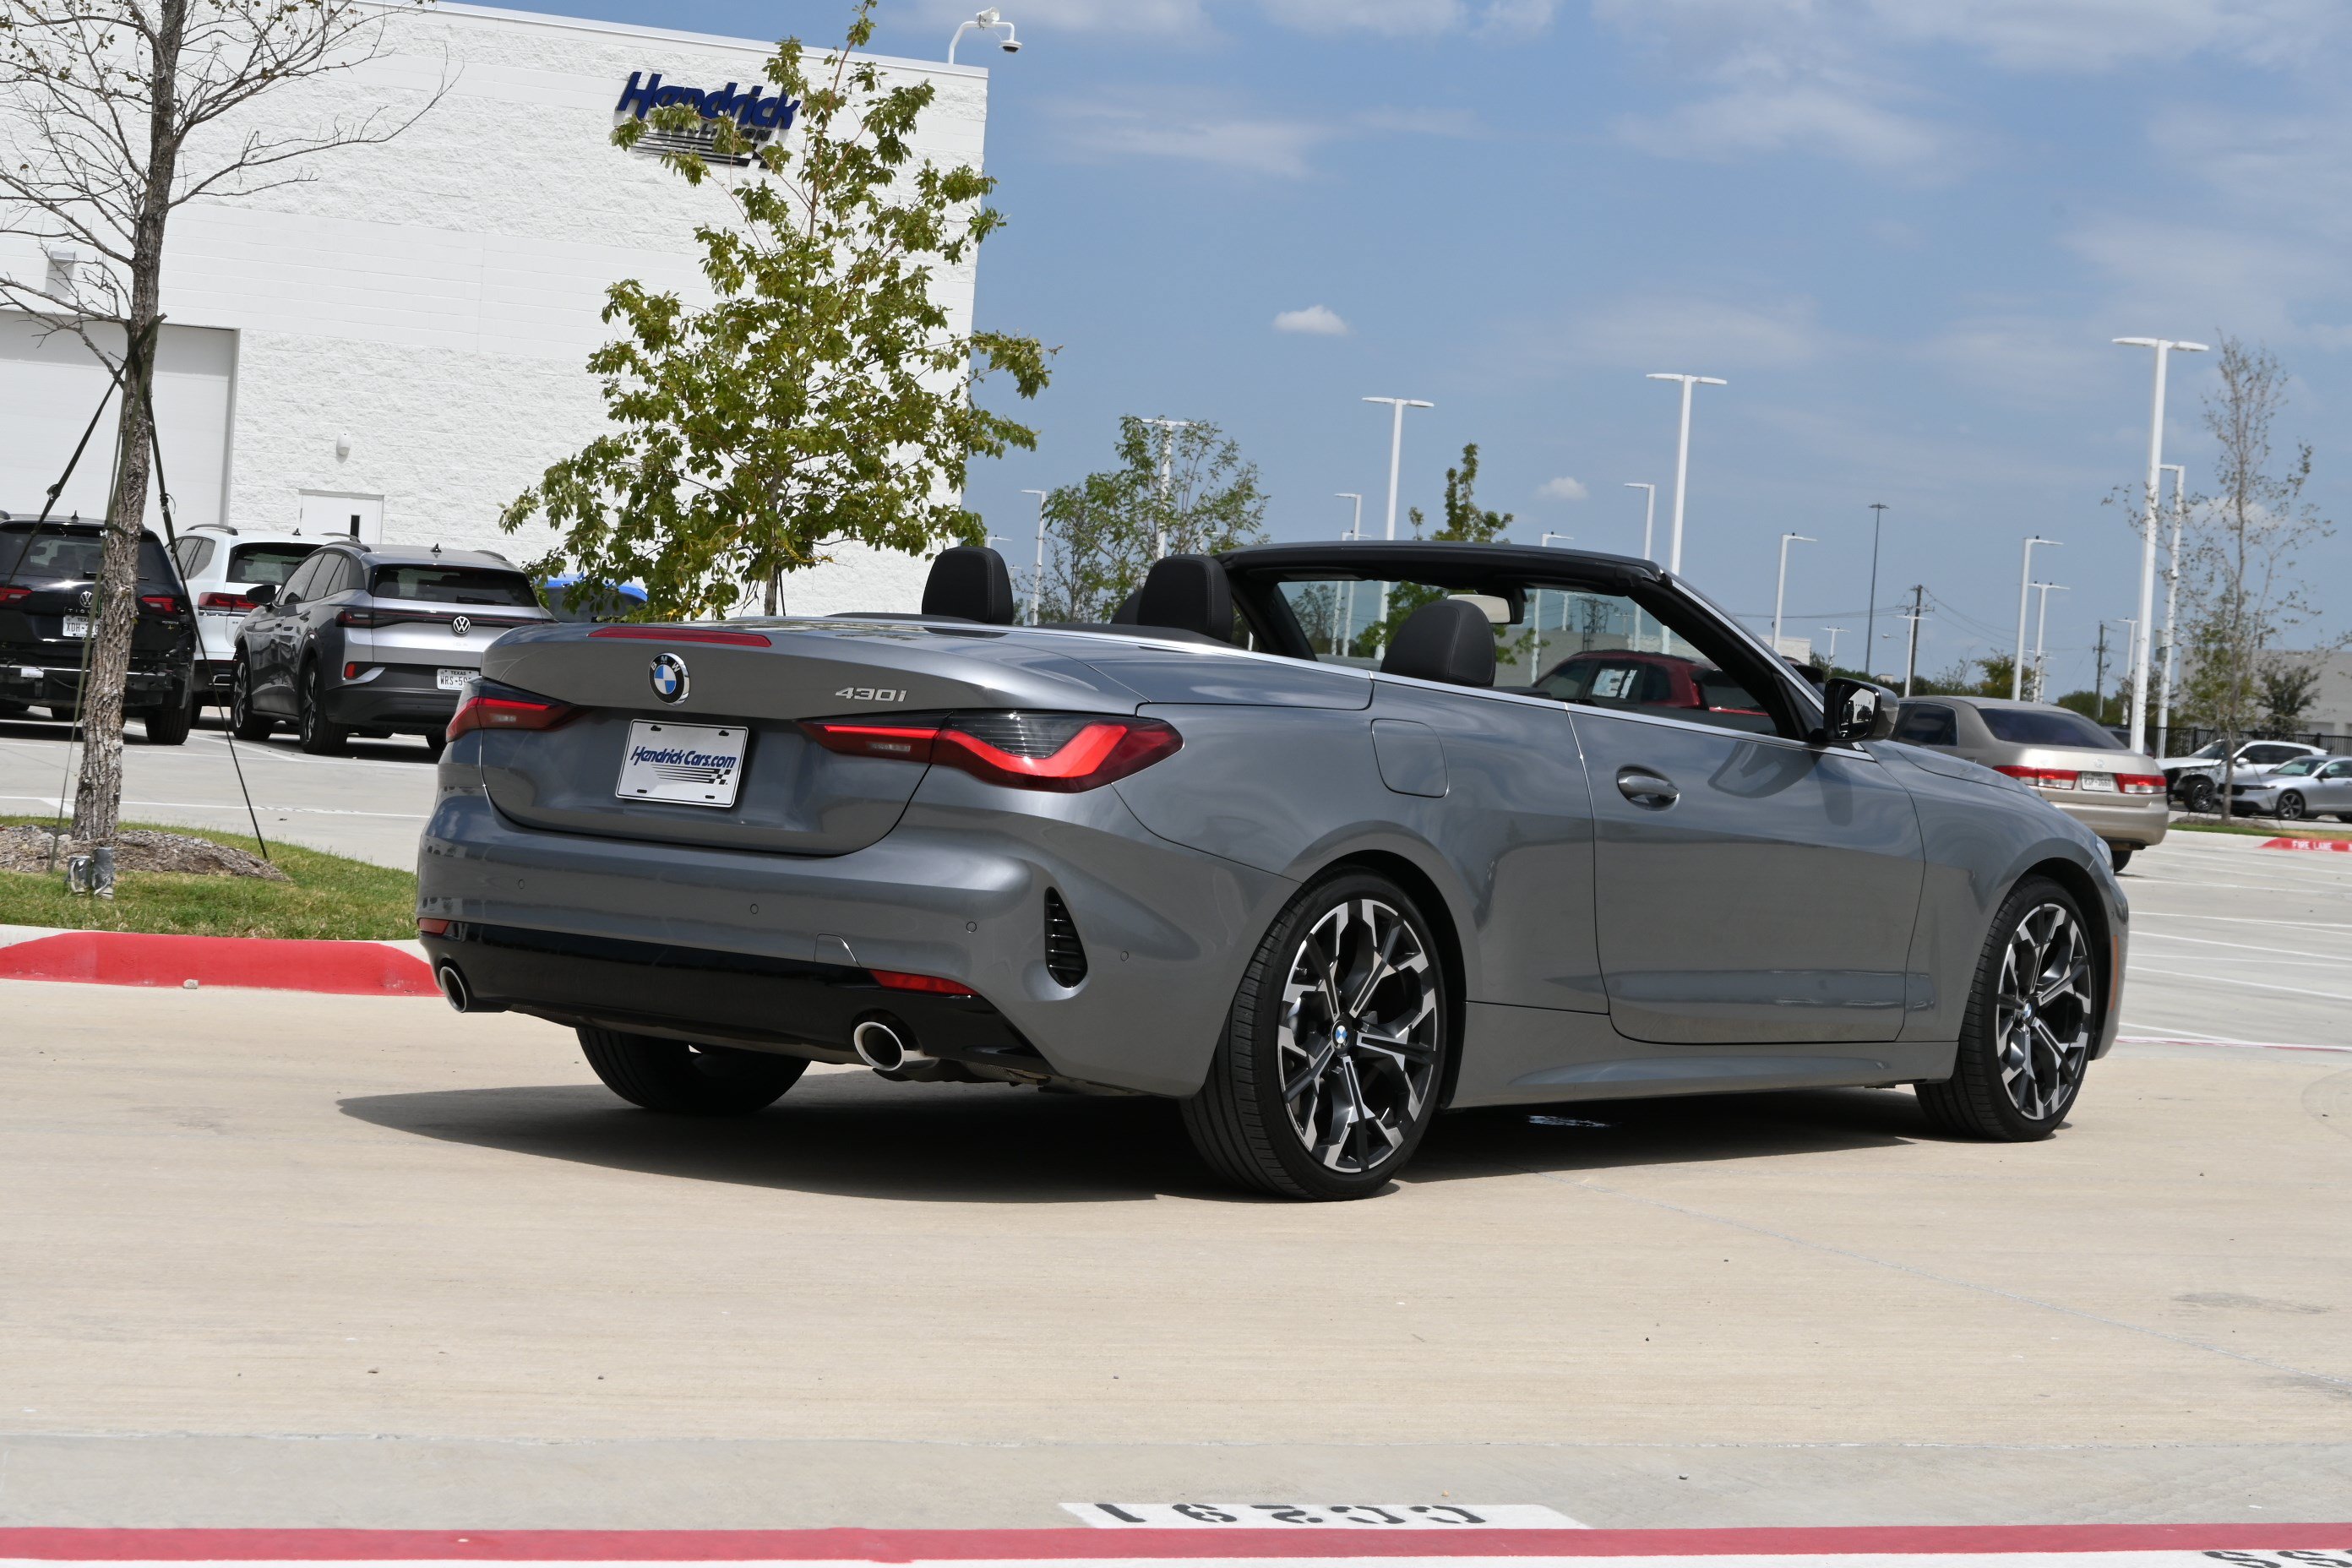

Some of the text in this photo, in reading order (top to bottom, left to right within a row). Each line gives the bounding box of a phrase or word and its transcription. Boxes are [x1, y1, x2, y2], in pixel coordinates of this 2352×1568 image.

[616, 71, 801, 130] Hendrick
[835, 687, 907, 702] 430i
[2291, 840, 2333, 852] FIRE LANE
